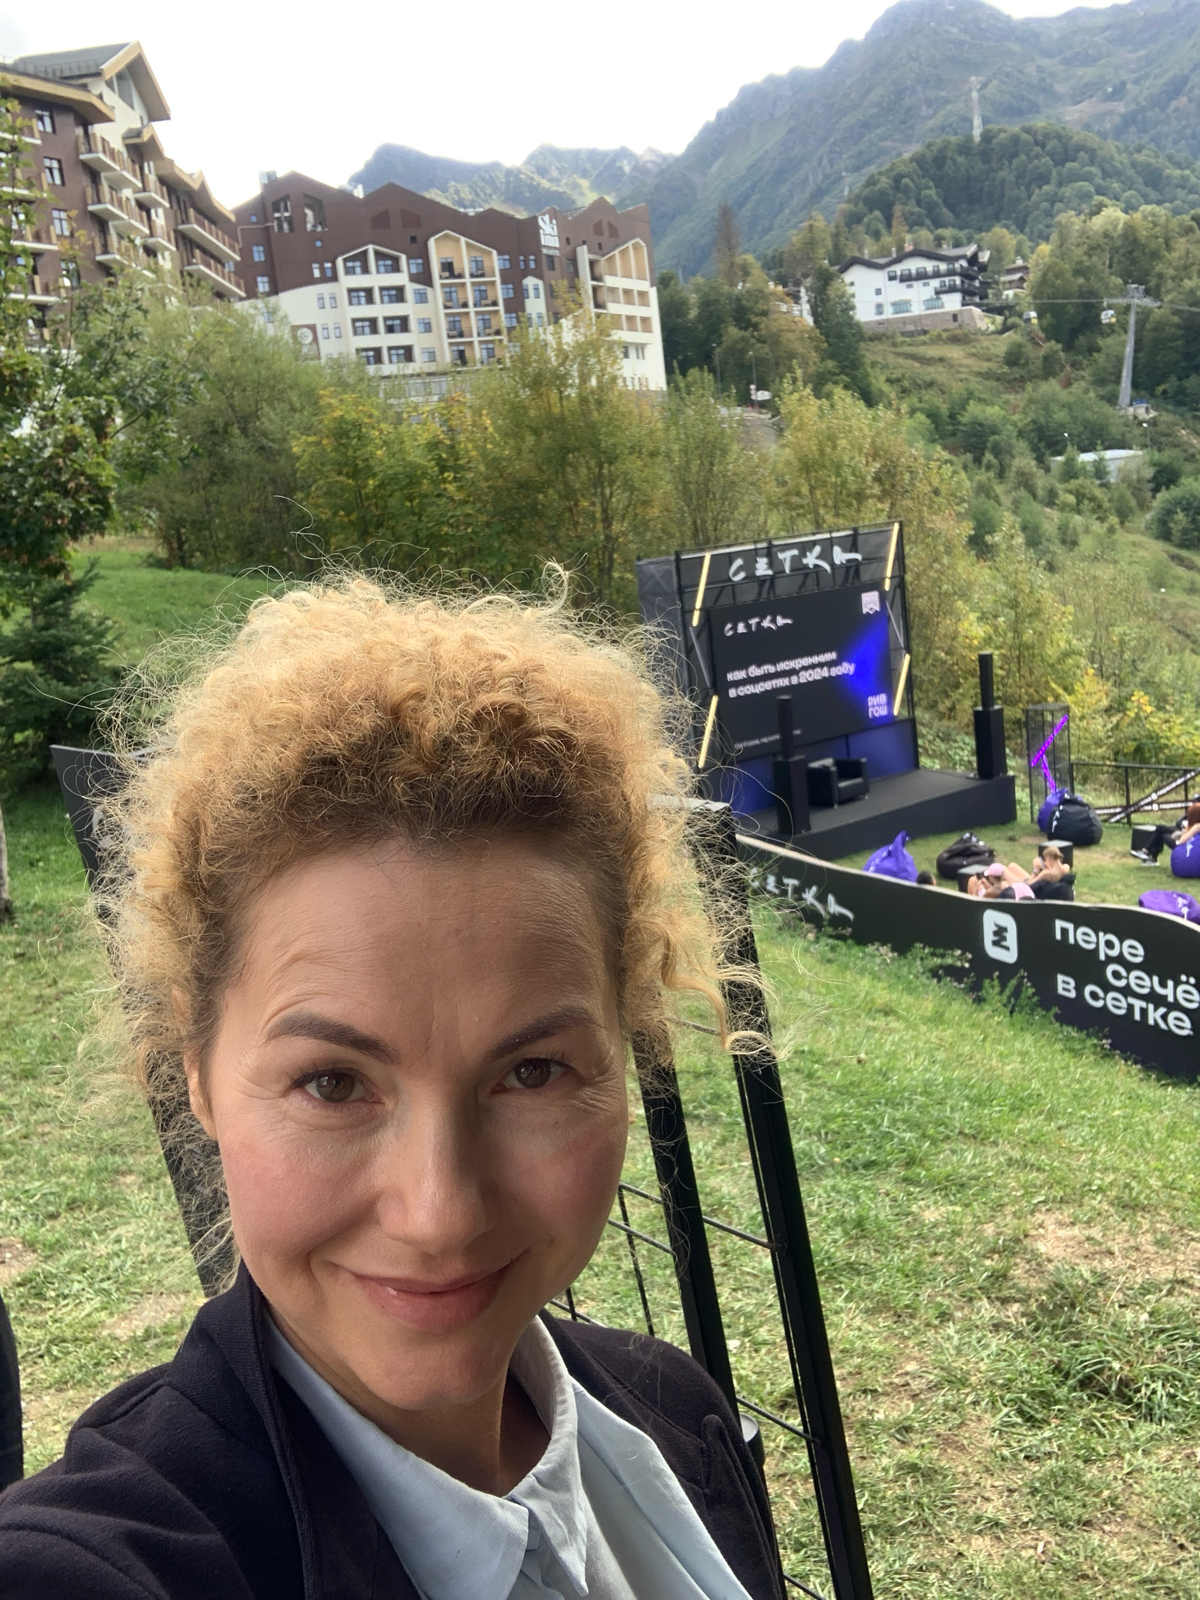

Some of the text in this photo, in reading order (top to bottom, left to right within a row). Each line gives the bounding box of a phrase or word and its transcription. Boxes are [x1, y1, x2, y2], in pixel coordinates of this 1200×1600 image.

[729, 545, 862, 581] СЕТКА
[724, 615, 793, 636] СЕТКА
[726, 651, 838, 682] как быть искренним
[728, 661, 856, 698] в соцсетях в 2024 году
[1055, 918, 1145, 963] пере
[1057, 973, 1192, 1036] в сетке
